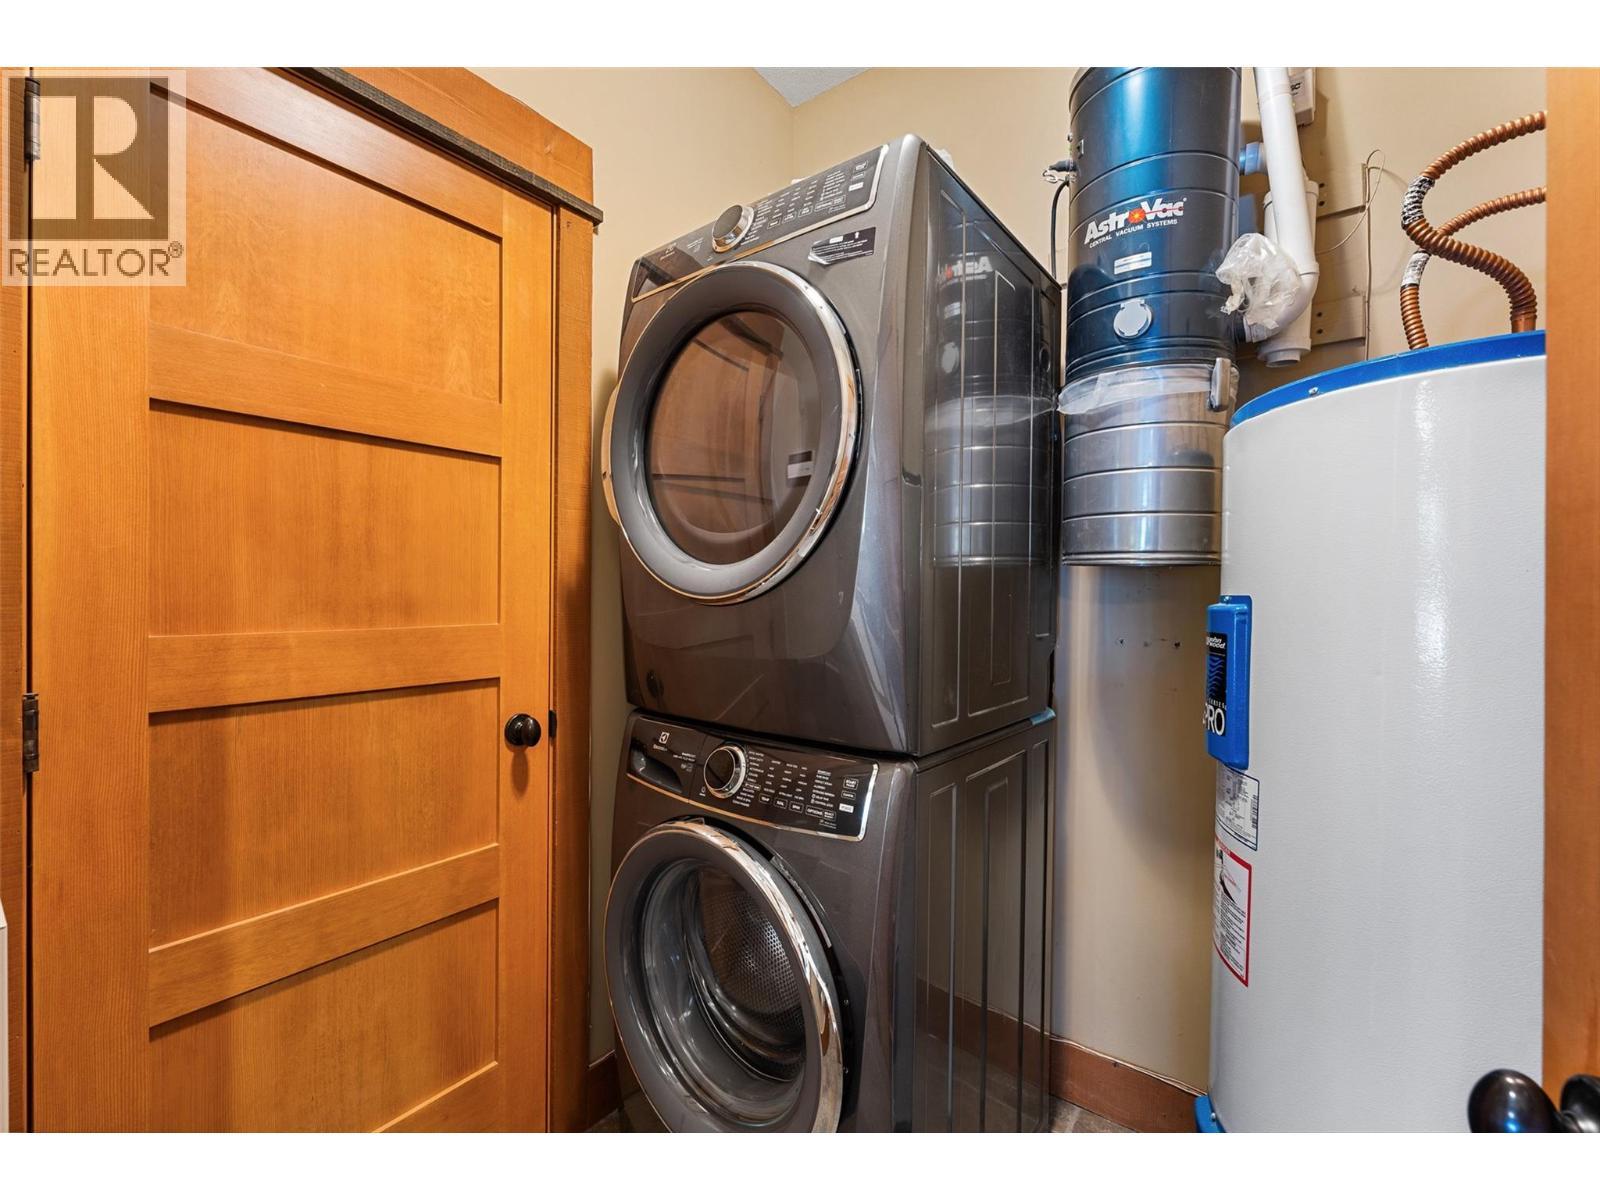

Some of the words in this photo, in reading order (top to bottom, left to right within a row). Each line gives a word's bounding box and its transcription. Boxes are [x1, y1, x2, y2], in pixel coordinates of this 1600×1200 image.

[1089, 235, 1112, 248] CENTRAL
[1115, 225, 1144, 237] VACUUM
[1146, 218, 1178, 229] SYSTEMS
